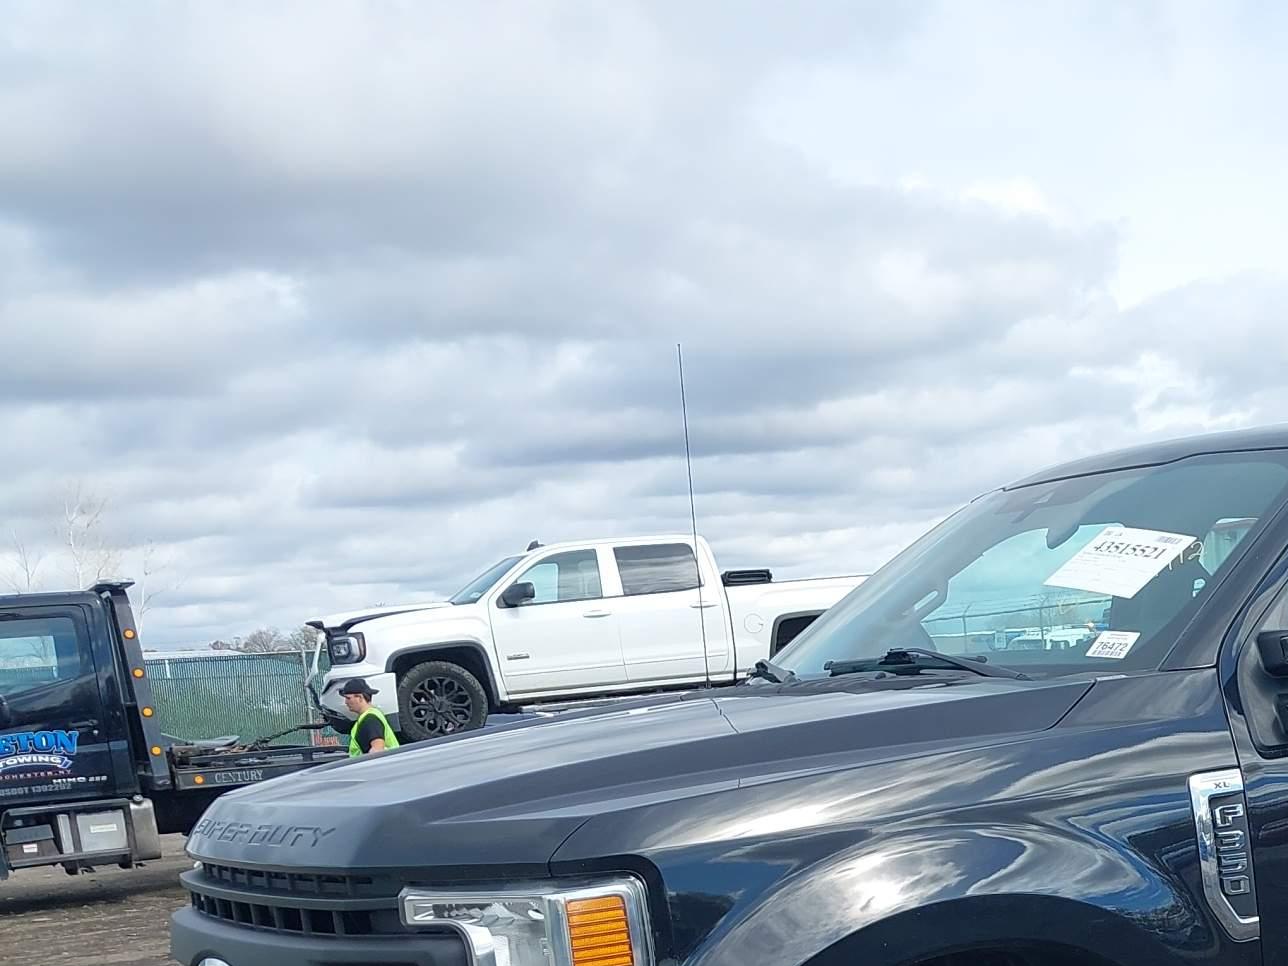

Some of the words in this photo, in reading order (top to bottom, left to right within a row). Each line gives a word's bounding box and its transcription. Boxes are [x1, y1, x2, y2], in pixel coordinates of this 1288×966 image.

[1094, 541, 1167, 560] 43515521
[1096, 641, 1129, 652] 76472
[214, 769, 265, 784] CENTURY
[1213, 782, 1231, 790] XL
[248, 823, 337, 848] DUTY
